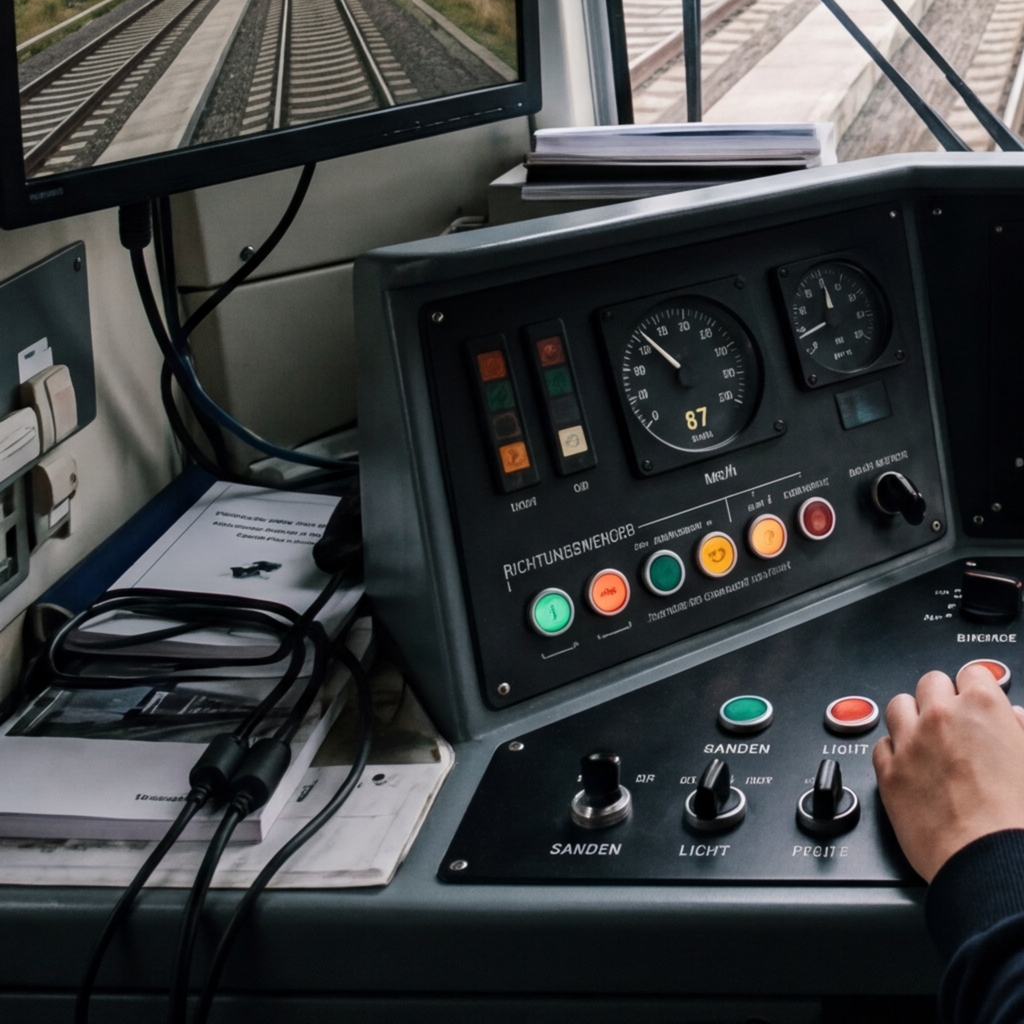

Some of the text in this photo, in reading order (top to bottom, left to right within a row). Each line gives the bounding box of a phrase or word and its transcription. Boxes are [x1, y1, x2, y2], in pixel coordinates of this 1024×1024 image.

[685, 406, 708, 431] 87
[704, 744, 771, 754] SANDEN
[550, 843, 622, 856] SANDEN
[679, 844, 731, 857] LICHT
